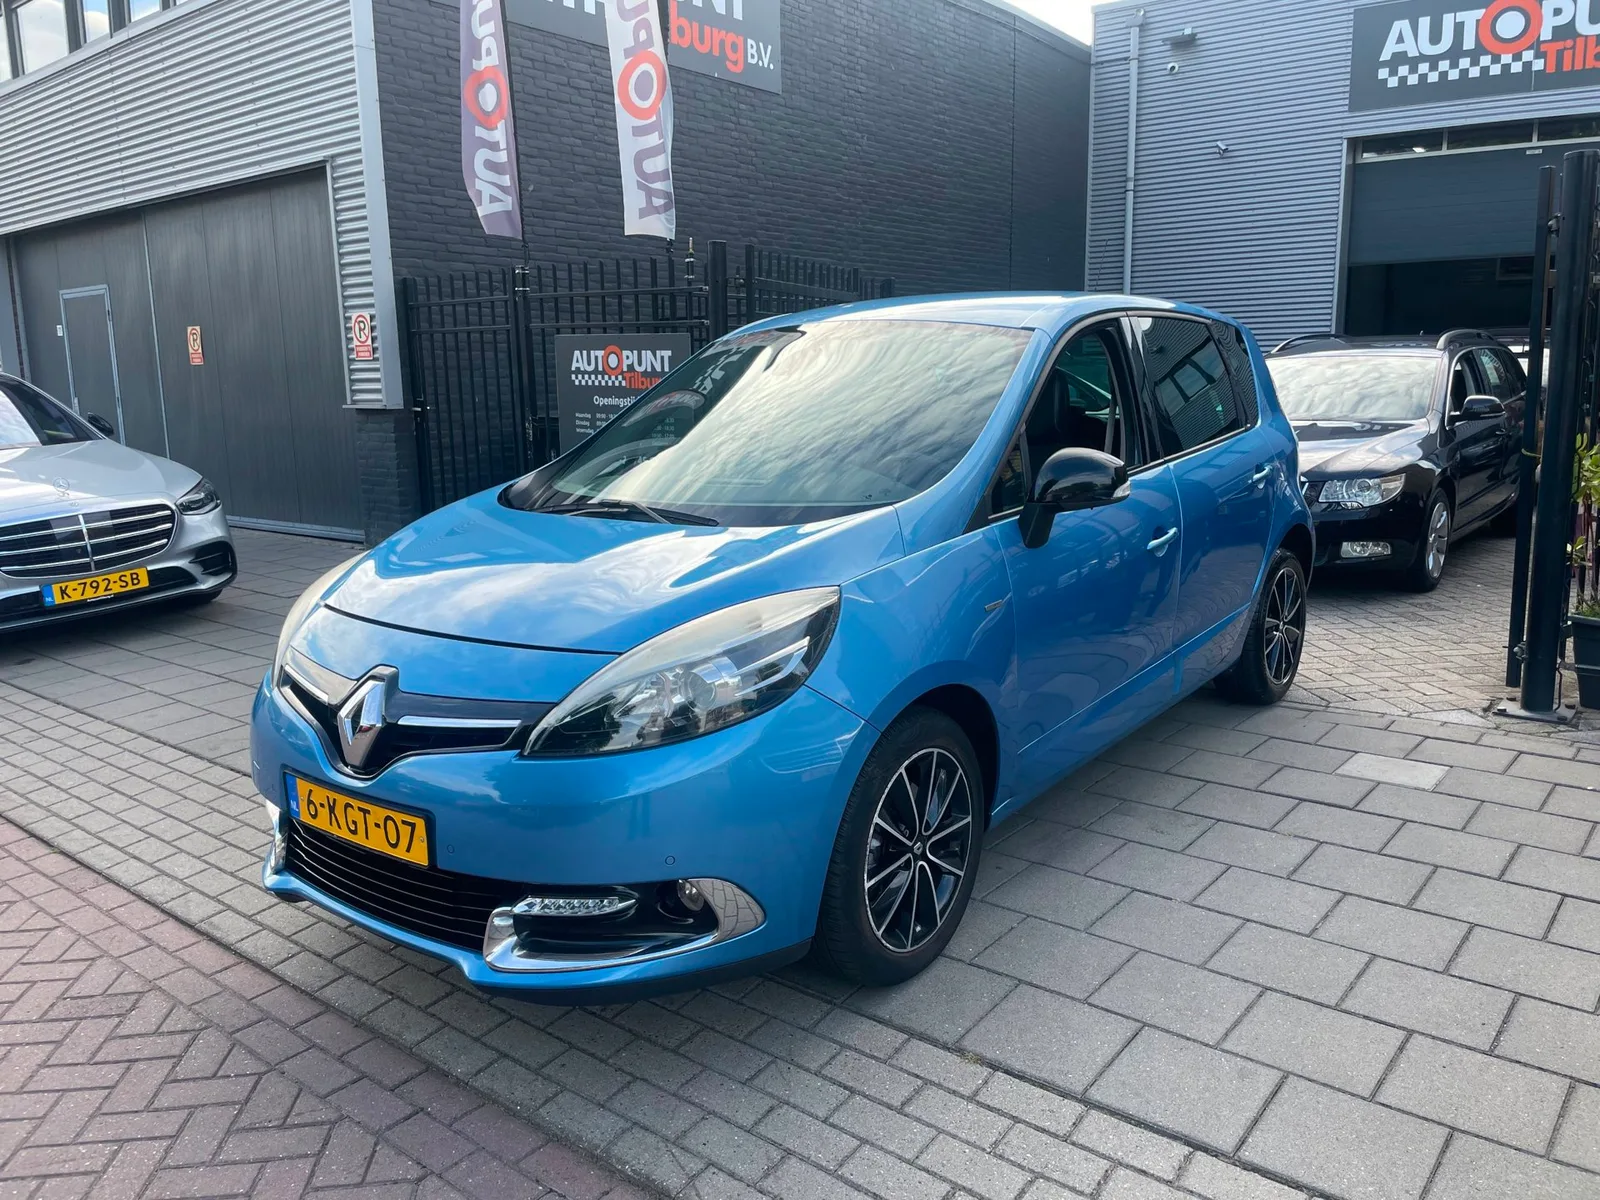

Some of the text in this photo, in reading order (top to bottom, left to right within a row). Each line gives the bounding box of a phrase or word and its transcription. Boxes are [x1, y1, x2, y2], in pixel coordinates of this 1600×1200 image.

[669, 0, 774, 73] burg B.V.
[571, 345, 672, 376] AUTOPUNT
[59, 572, 140, 600] K-792-SB
[306, 789, 417, 853] 6-KGT-07
